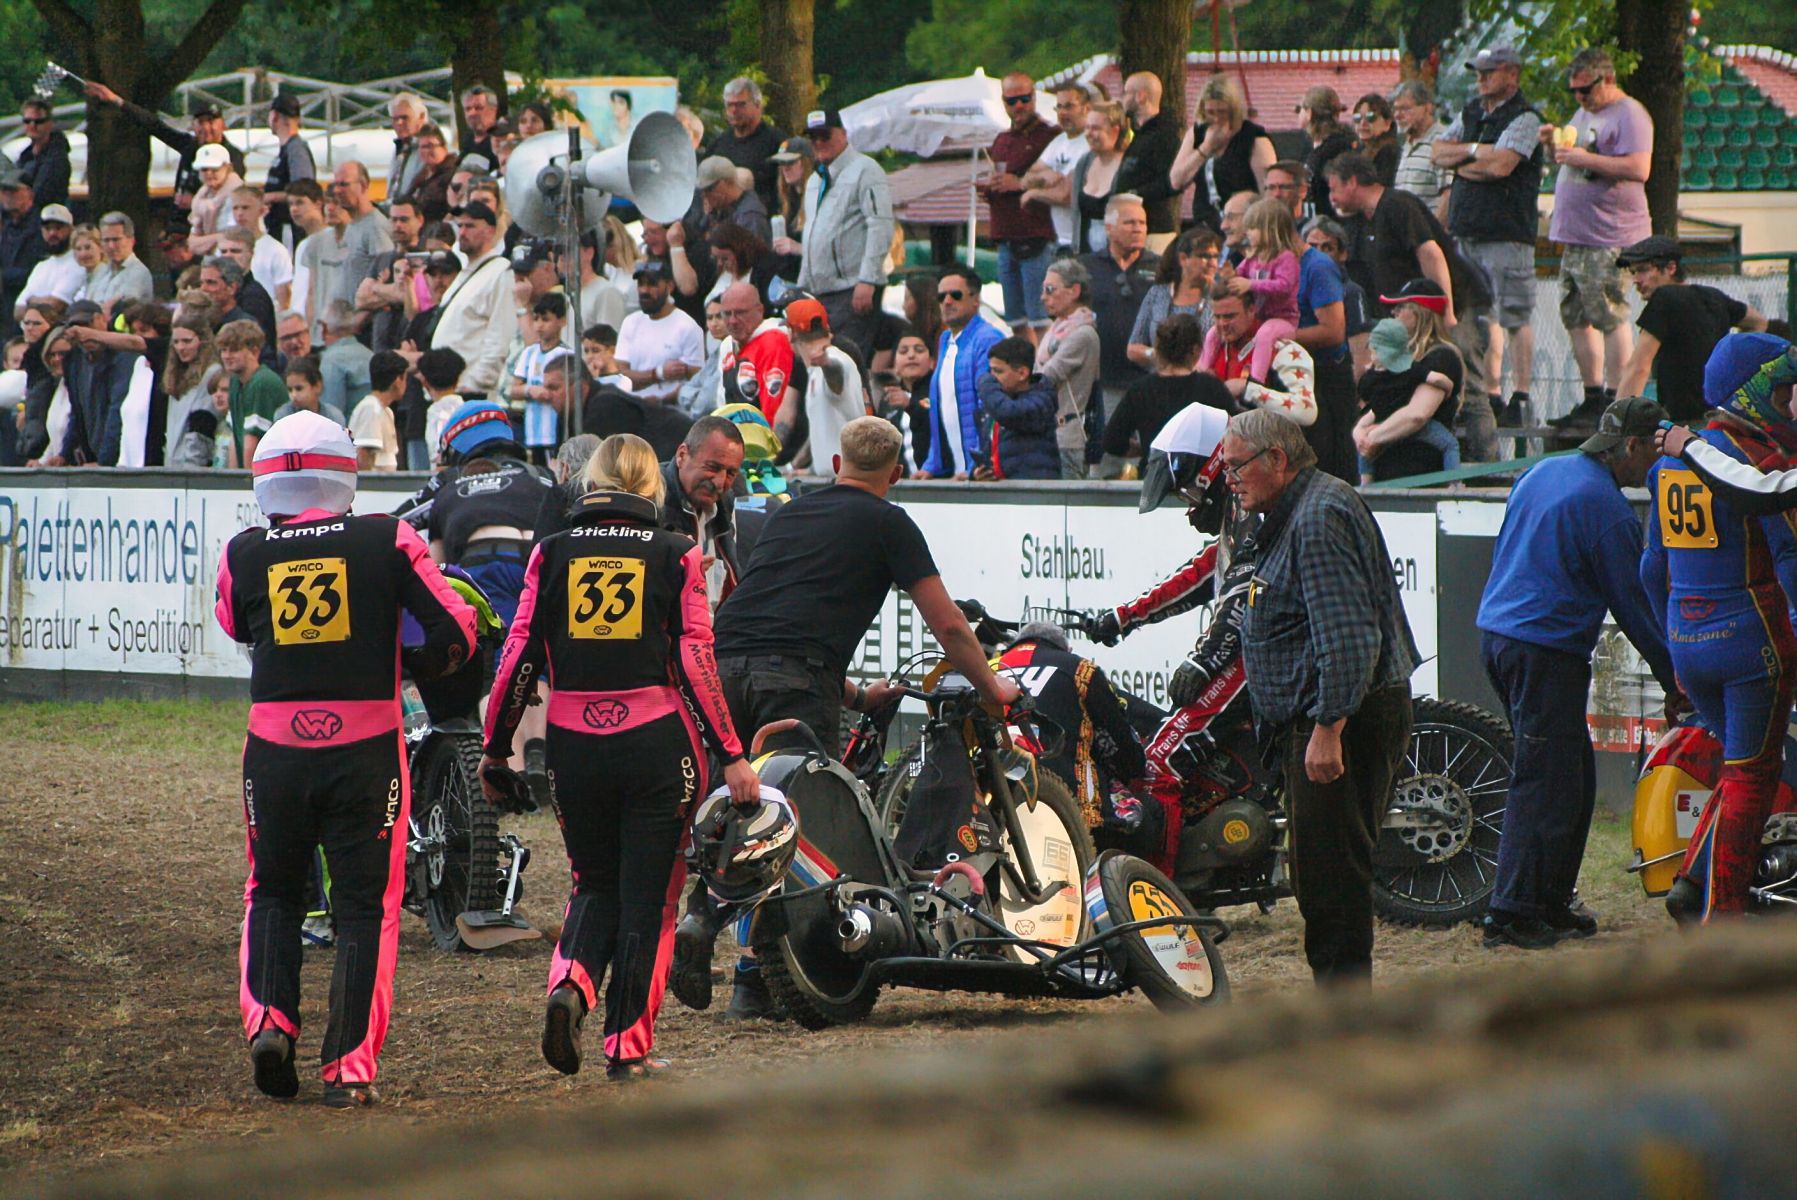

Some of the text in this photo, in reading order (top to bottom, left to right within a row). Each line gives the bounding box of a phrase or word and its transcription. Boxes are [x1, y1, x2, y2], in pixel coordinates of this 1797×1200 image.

[265, 522, 344, 541] Kempa
[570, 526, 654, 541] Stickling
[1667, 483, 1706, 538] 95
[0, 496, 206, 586] Palettenhandel
[288, 562, 324, 572] WACO
[589, 560, 623, 570] WACO
[277, 573, 341, 629] 33
[574, 572, 637, 623] 33
[108, 607, 205, 663] Spedition
[510, 663, 533, 708] WACO
[1197, 674, 1226, 709] Trans
[1151, 712, 1191, 760] Trans MF
[384, 778, 399, 827] WACO
[1678, 794, 1691, 812] E
